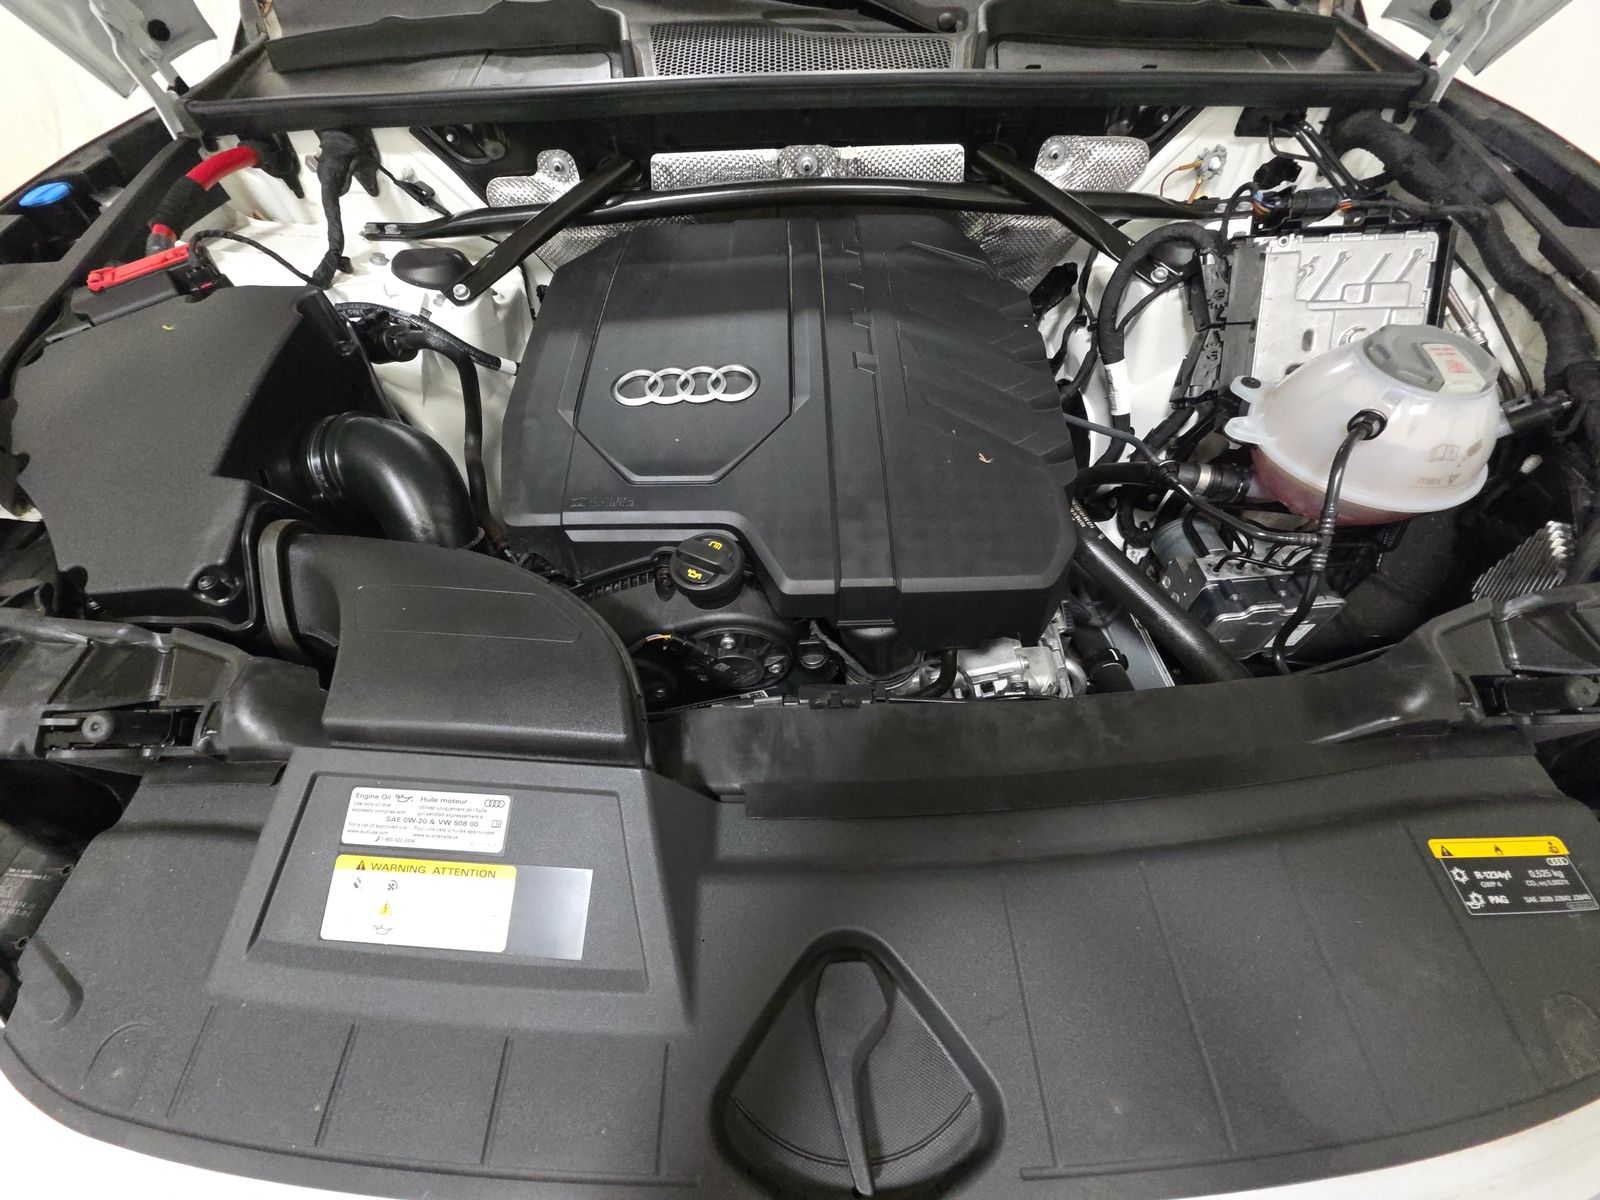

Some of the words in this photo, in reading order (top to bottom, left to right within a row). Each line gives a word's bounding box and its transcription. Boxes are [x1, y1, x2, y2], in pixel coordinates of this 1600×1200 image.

[355, 792, 380, 800] Engine
[370, 862, 427, 874] WARNING
[432, 866, 497, 879] ATTENTION
[1551, 869, 1566, 879] kg
[1487, 895, 1511, 905] PAG
